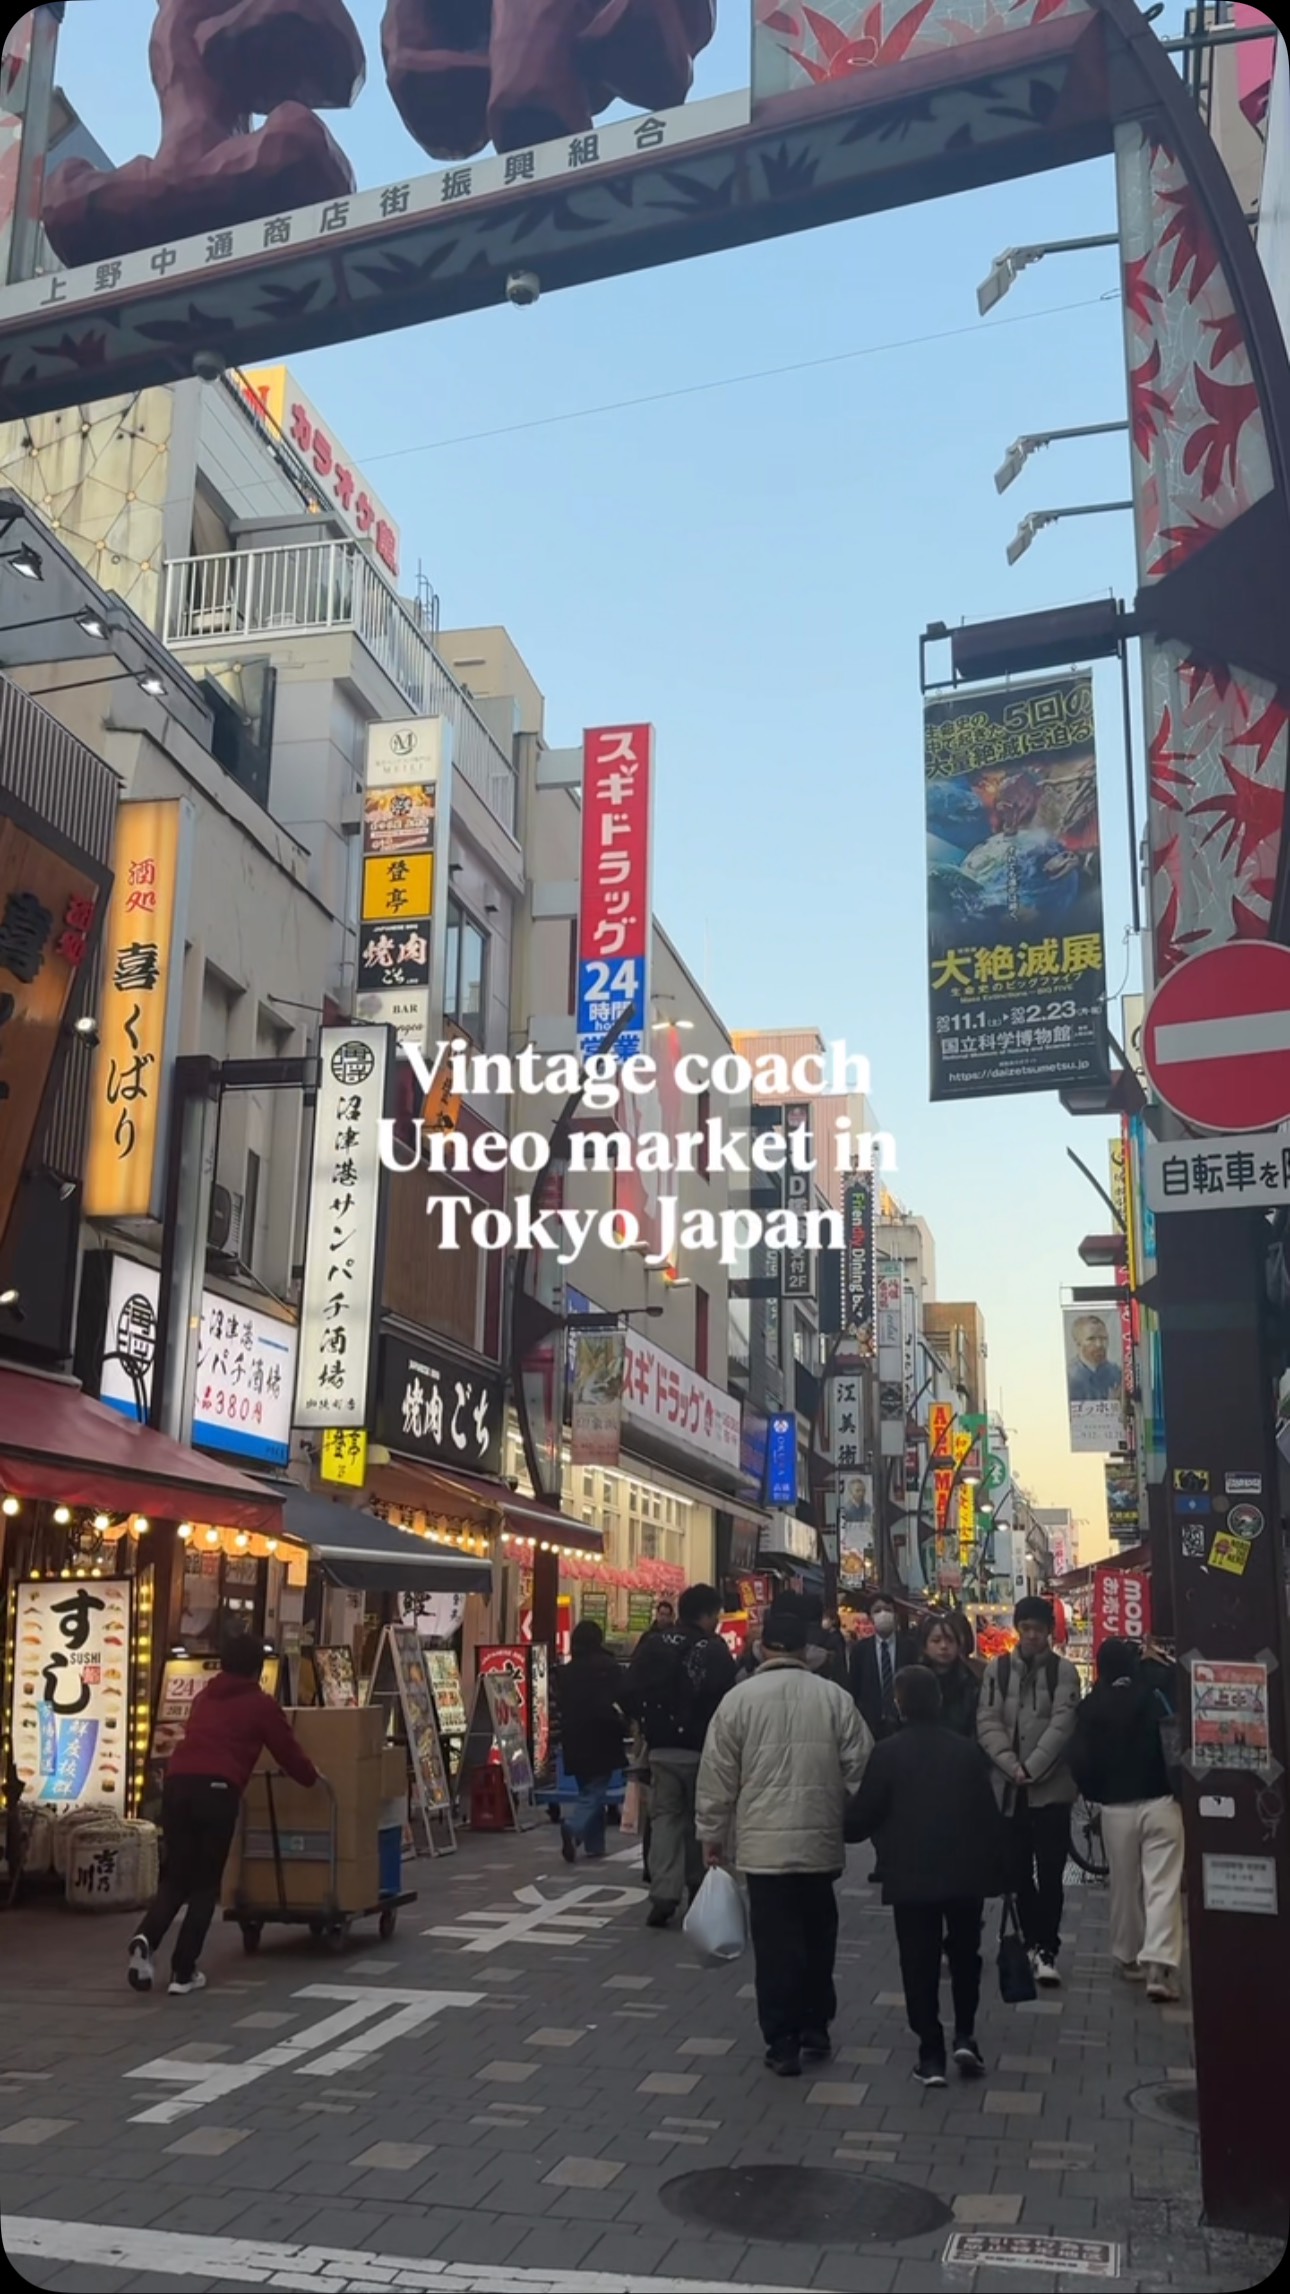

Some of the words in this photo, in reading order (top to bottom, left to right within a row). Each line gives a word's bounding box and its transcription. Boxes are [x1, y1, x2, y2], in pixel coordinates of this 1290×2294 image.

[40, 117, 668, 306] 上野中通商店街振興組合
[596, 731, 639, 956] スギドラッグ
[126, 858, 157, 914] 酒処
[362, 931, 428, 968] 焼肉
[932, 933, 1102, 990] 大絶滅展
[392, 1004, 419, 1014] BAR
[583, 959, 639, 1003] 24
[107, 942, 161, 1159] 喜くばり
[941, 1025, 1072, 1055] 国立科学博物館
[1163, 1150, 1290, 1196] 自転車を
[319, 1095, 363, 1389] 沼津港サンパチ酒場
[622, 1347, 704, 1434] スギドラッグ
[43, 1588, 106, 1715] すし
[69, 1652, 102, 1665] SUSHI
